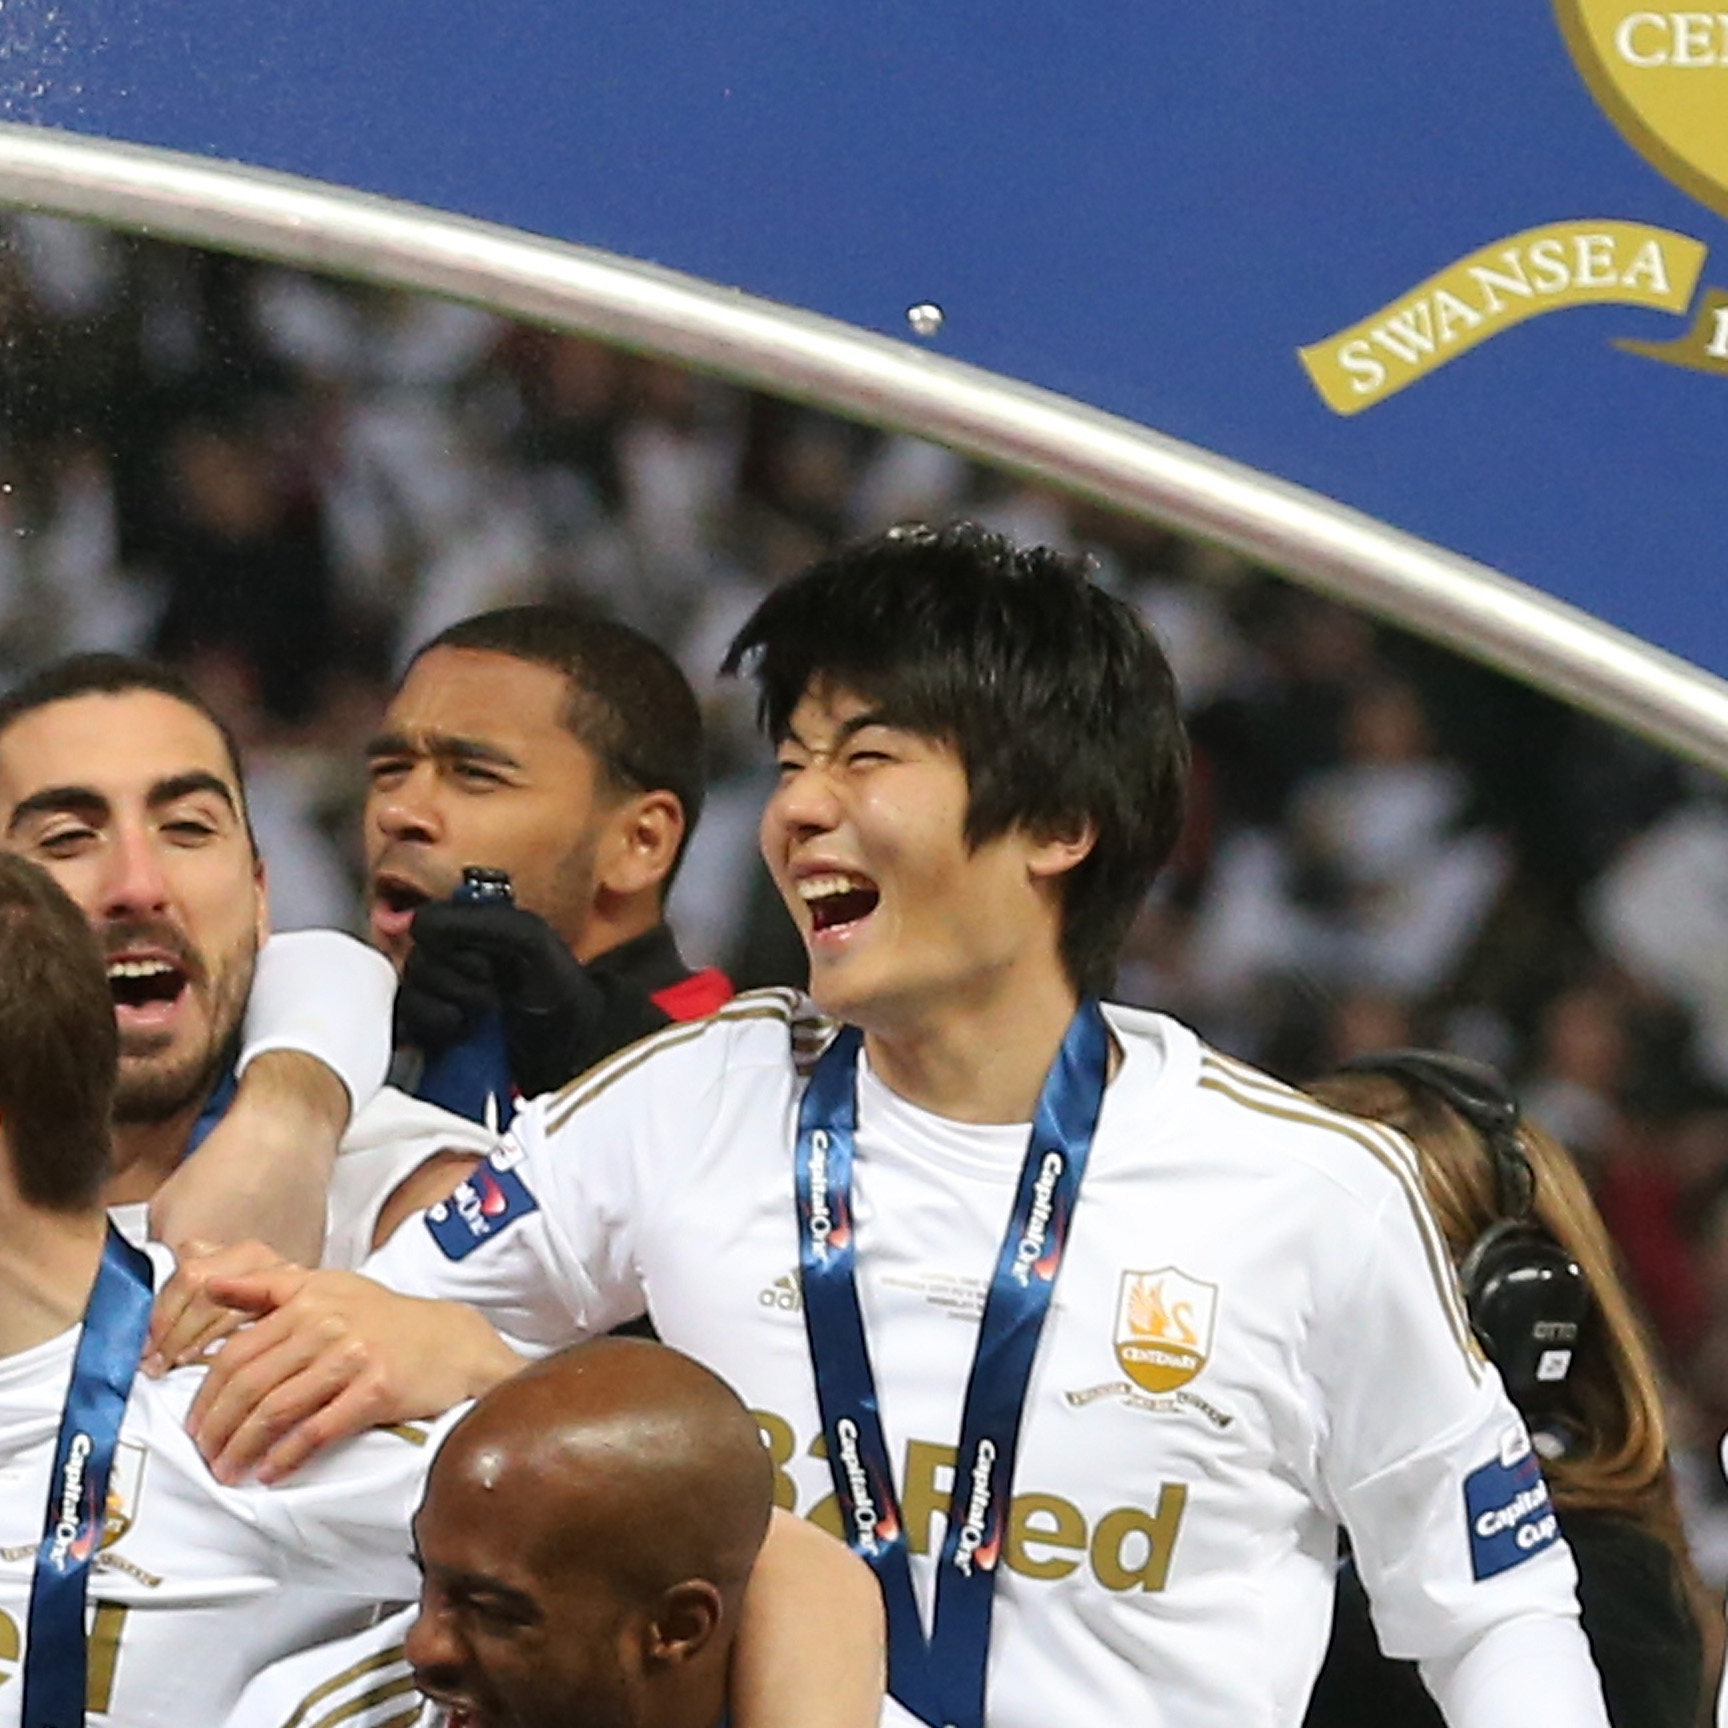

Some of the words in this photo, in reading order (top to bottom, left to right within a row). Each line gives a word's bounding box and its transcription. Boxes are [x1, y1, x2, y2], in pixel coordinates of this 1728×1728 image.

[1614, 12, 1728, 67] CE
[1338, 235, 1671, 393] SWANSEA
[1475, 1479, 1548, 1538] Capital
